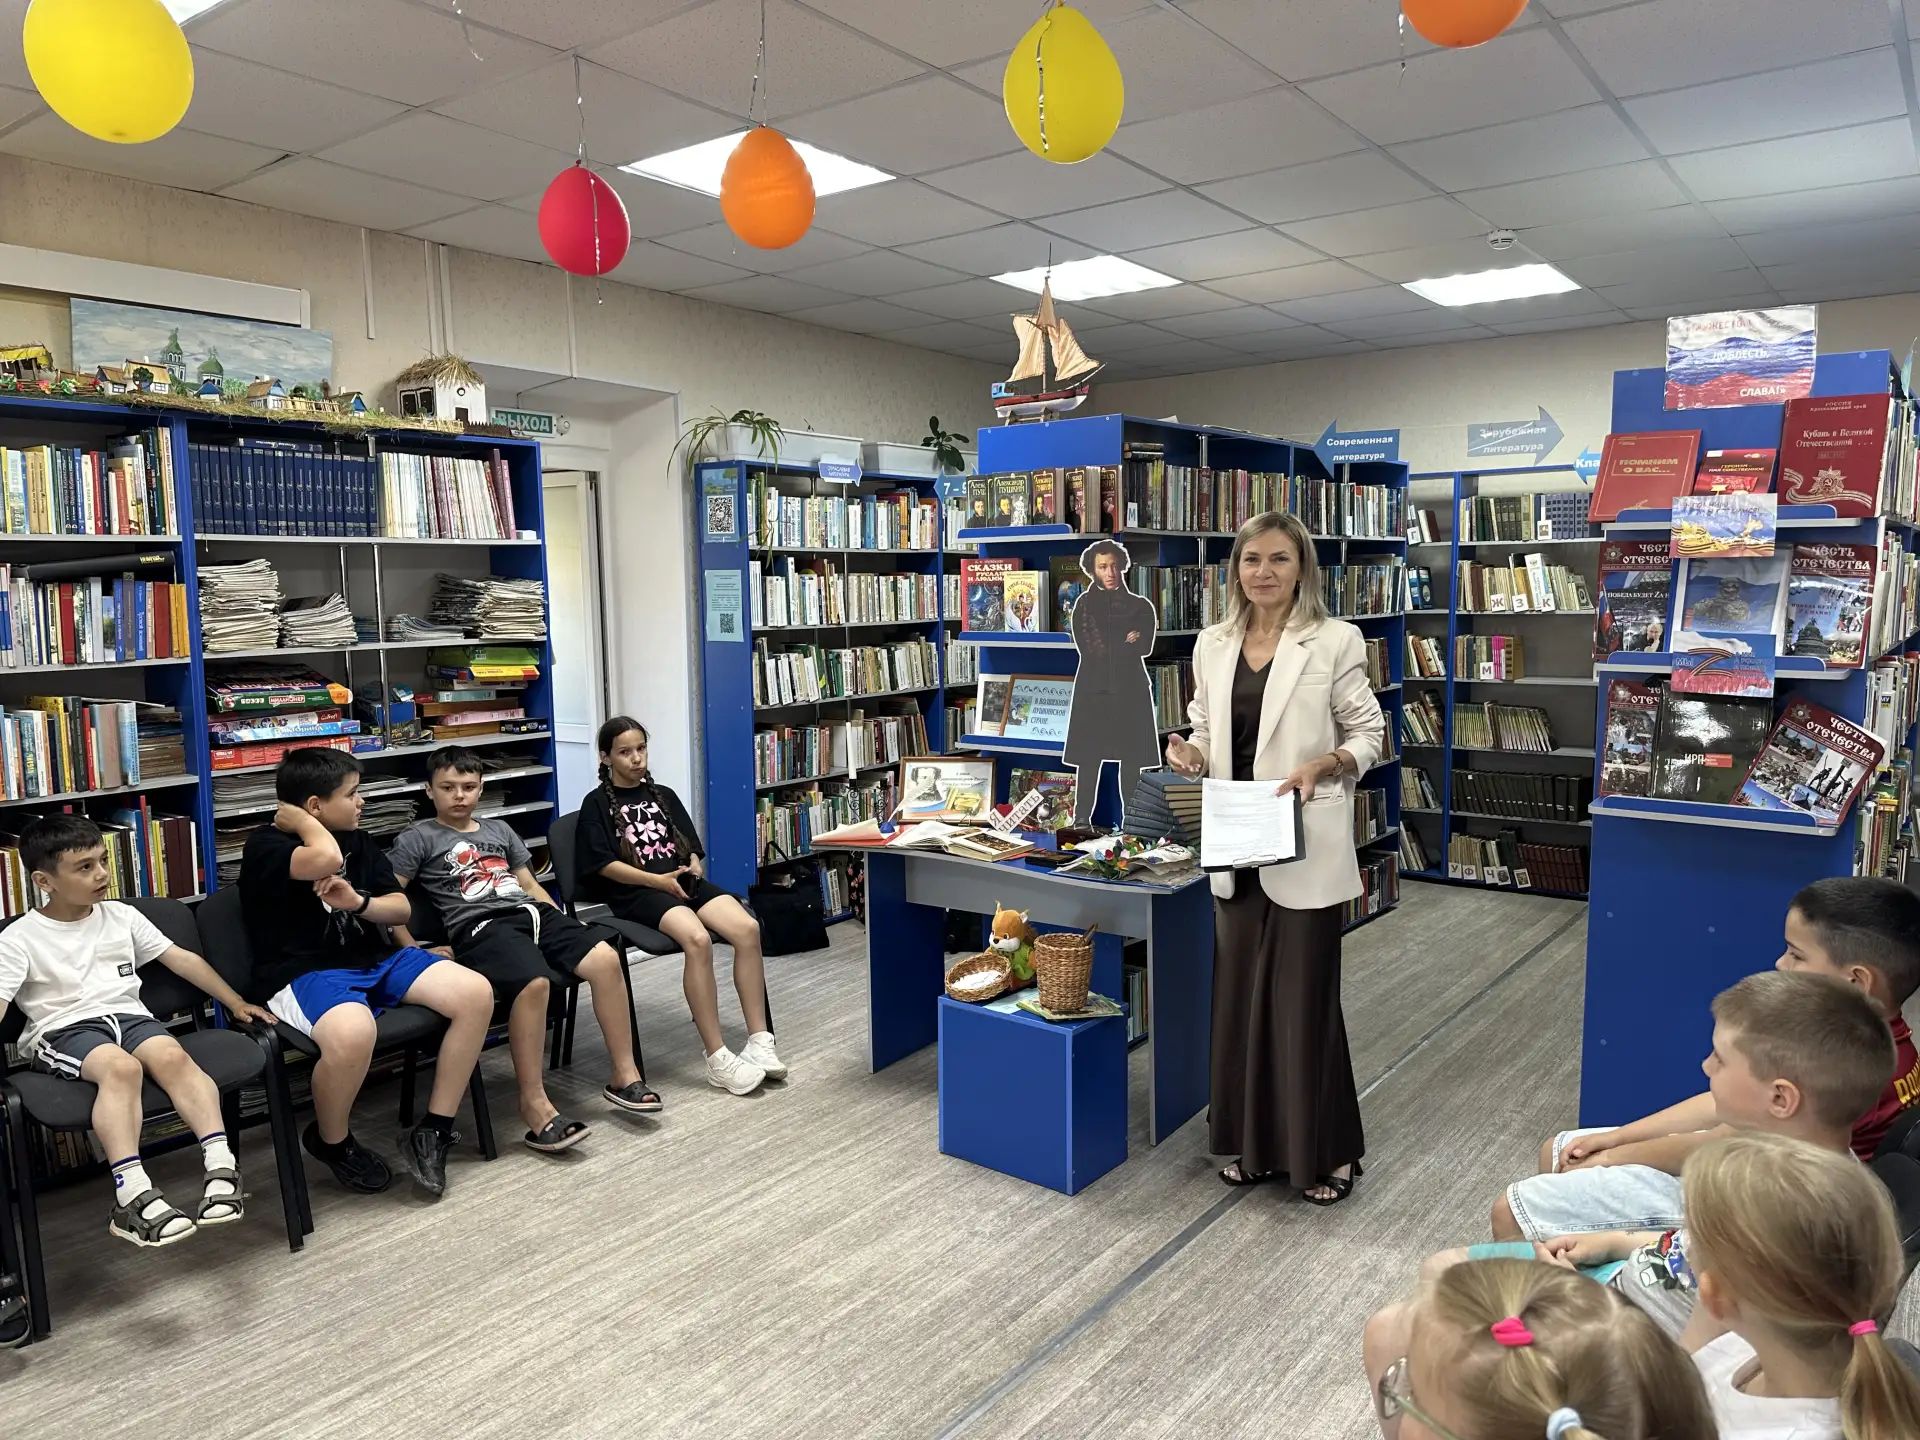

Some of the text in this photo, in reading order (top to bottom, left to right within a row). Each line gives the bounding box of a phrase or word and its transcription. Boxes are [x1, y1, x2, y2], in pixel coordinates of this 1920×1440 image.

[1712, 349, 1770, 361] ДОБЛЕСТЬ,
[1739, 386, 1787, 397] СЛАВА!»
[497, 411, 551, 432] ВЫХОД
[1479, 426, 1547, 439] Зарубежная
[1803, 429, 1830, 439] Кубань
[1840, 428, 1874, 437] Великой
[1326, 435, 1394, 447] Современная
[1796, 439, 1853, 448] Отечественной
[1483, 442, 1544, 455] литература
[1332, 451, 1386, 462] литература
[1619, 458, 1679, 466] ПОМНИМ
[944, 483, 950, 495] 7
[995, 479, 1025, 488] Александр
[998, 487, 1025, 495] ПУШКИН
[1128, 508, 1137, 521] М
[1811, 547, 1855, 557] ЧЕСТЬ
[967, 564, 1013, 572] СКАЗКИ
[1793, 558, 1872, 570] ОТЕЧЕСТВА
[1492, 597, 1504, 608] Ж
[1542, 598, 1551, 607] К
[1675, 657, 1693, 666] МЫ
[1481, 665, 1492, 675] М
[269, 695, 305, 704] МИЛЛИОНЕР
[1830, 716, 1867, 743] ЧЕСТЬ
[1805, 721, 1876, 761] ОТЕЧЕСТВА
[1685, 753, 1705, 765] ИРП
[989, 795, 1040, 833] Я читать
[1451, 865, 1458, 873] У
[1464, 868, 1474, 876] Ф
[1487, 869, 1495, 878] Ч
